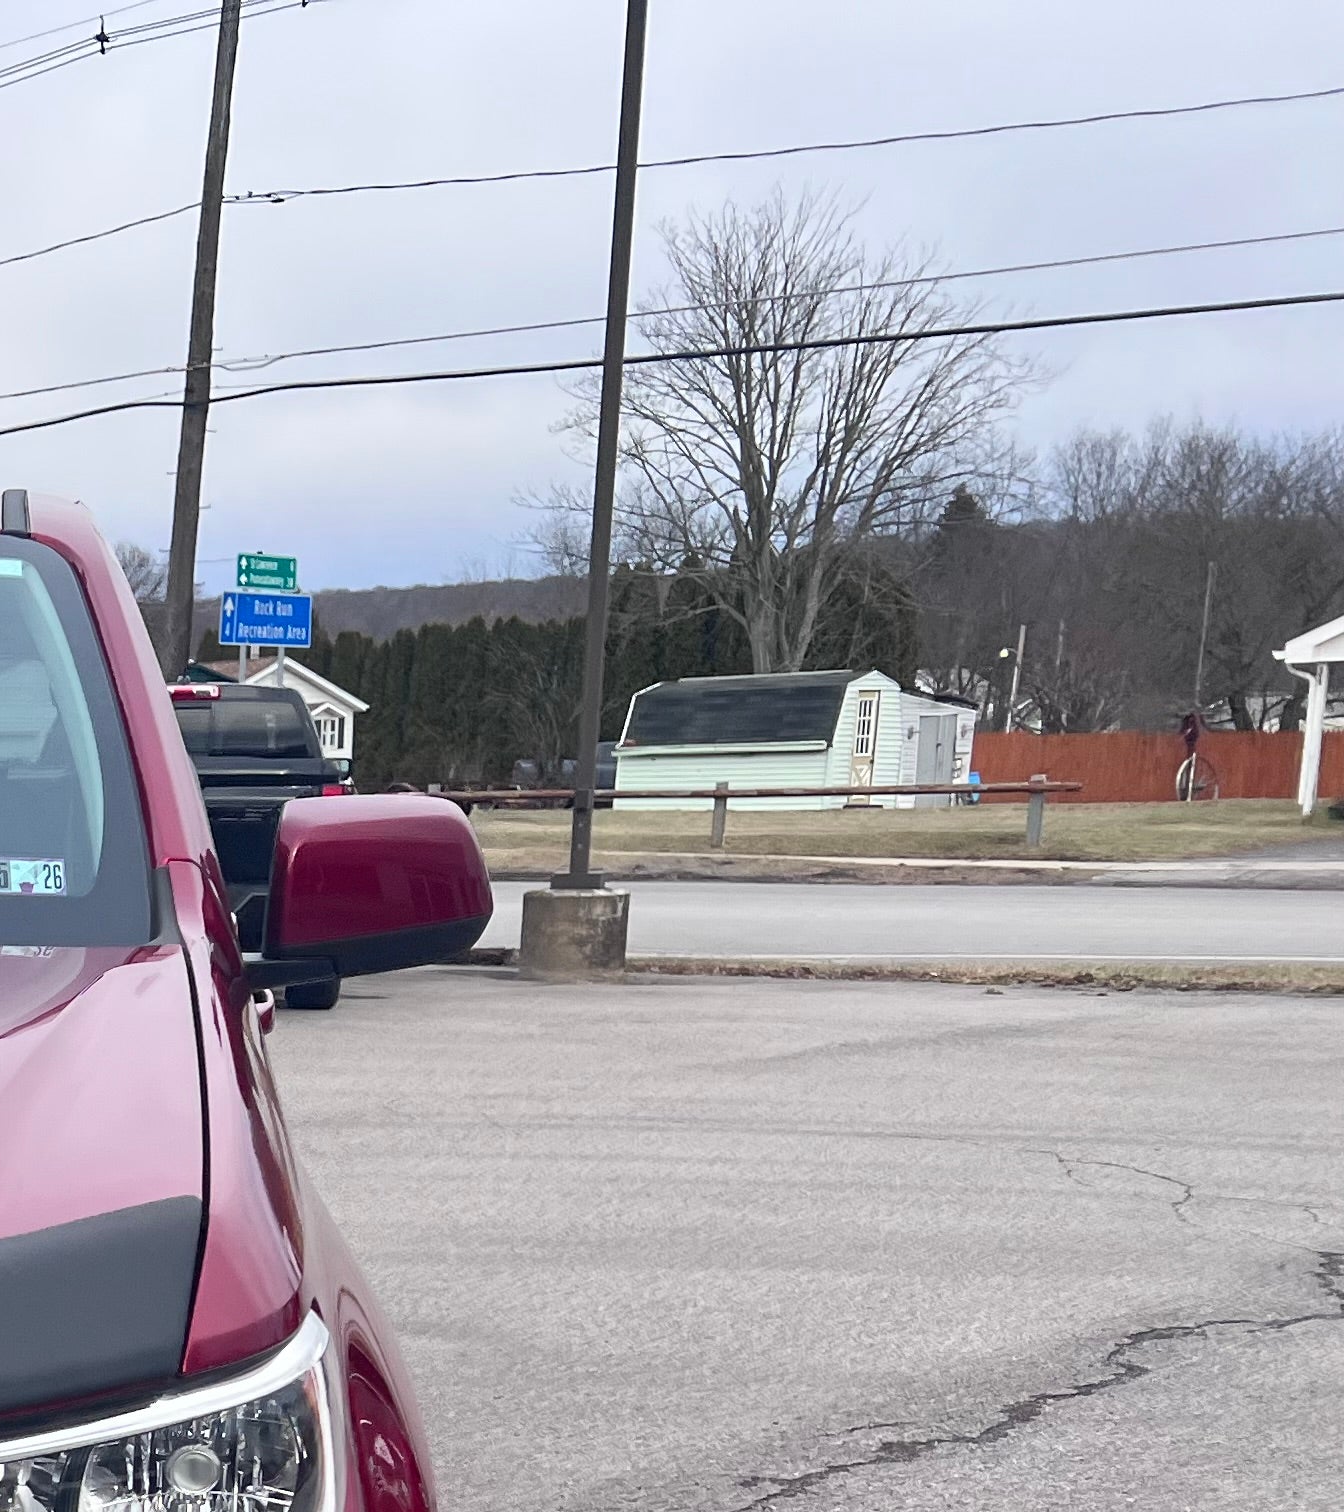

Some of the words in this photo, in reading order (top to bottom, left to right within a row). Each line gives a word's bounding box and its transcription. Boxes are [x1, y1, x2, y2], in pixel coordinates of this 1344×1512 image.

[254, 600, 274, 616] Rock
[276, 601, 293, 617] Run
[237, 623, 284, 639] Recreation
[286, 624, 306, 640] Area
[43, 864, 63, 889] 26
